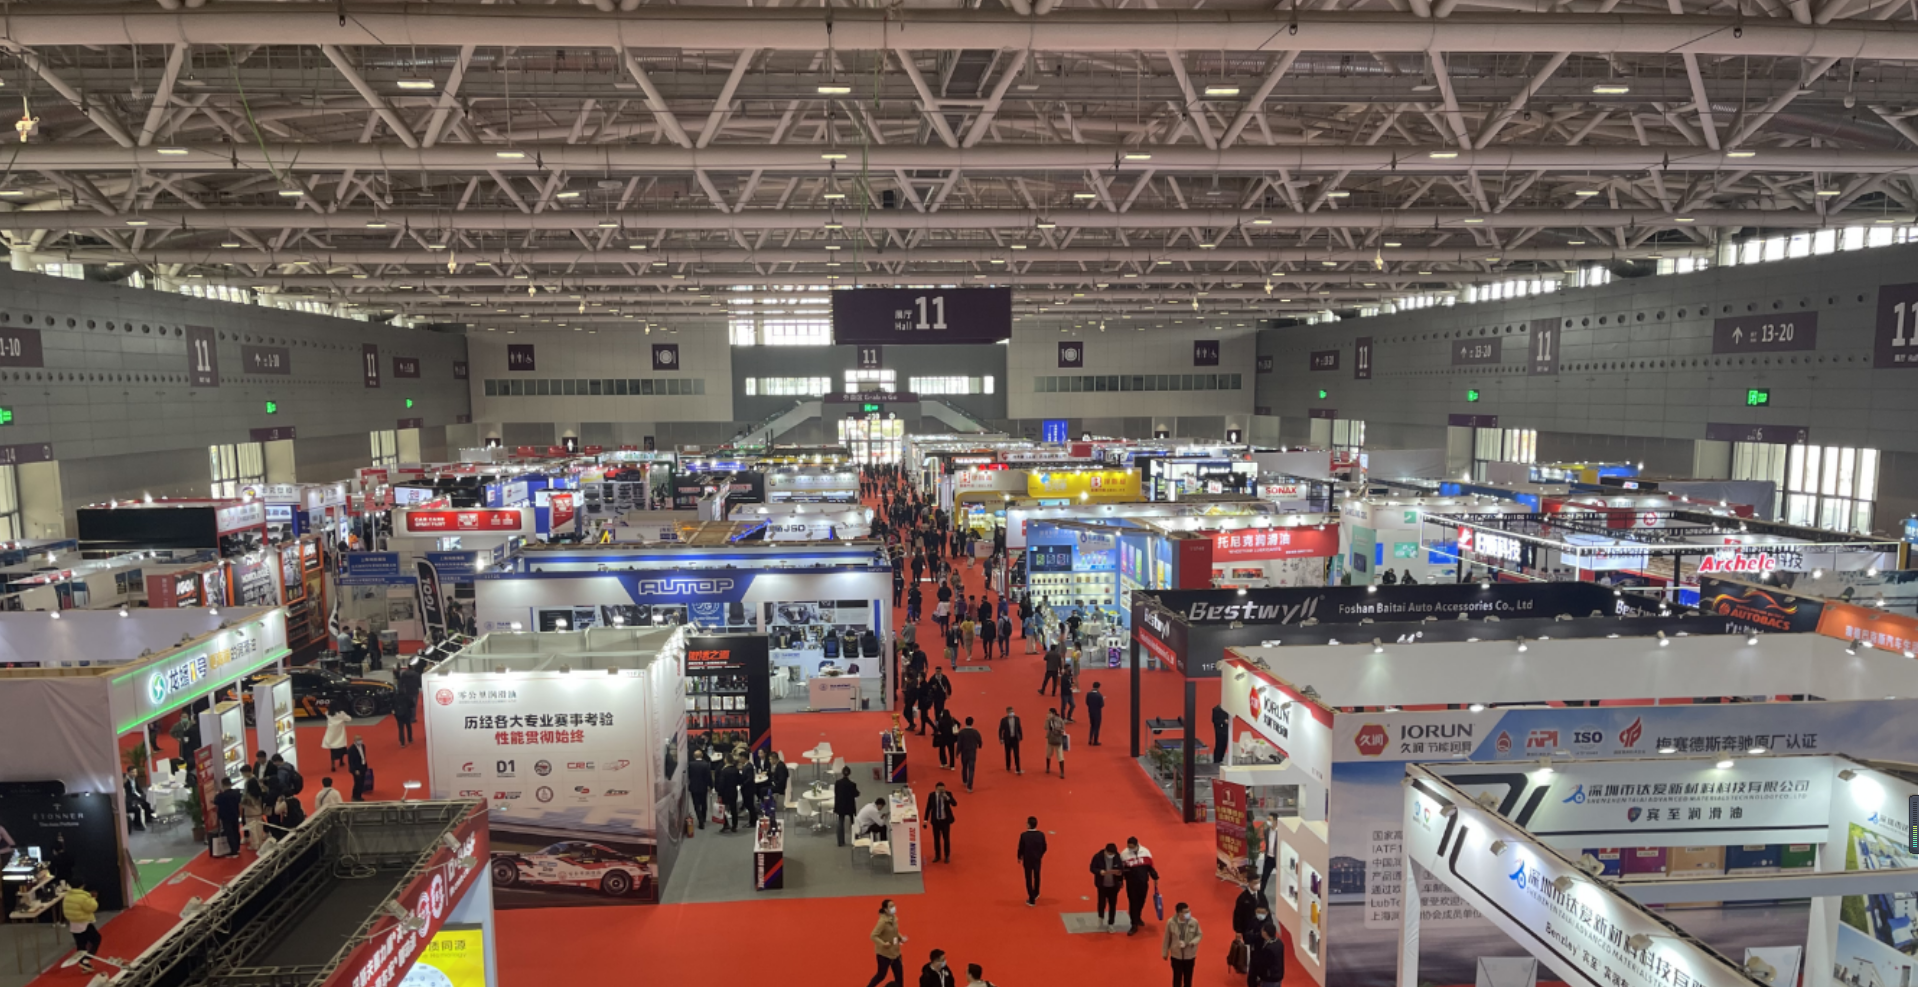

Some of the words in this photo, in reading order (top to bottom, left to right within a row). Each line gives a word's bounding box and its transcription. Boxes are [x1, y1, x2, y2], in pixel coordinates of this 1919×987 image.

[915, 296, 948, 330] 11
[895, 322, 912, 330] Hall
[1761, 323, 1794, 342] 13-20
[1475, 345, 1491, 358] 13-20
[1537, 331, 1551, 361] 11
[195, 339, 211, 371] 11
[863, 349, 877, 364] 11
[1359, 346, 1368, 369] 11
[366, 353, 376, 377] 11
[1756, 428, 1762, 441] 6
[1265, 486, 1297, 494] SONAX
[1217, 533, 1291, 549] 托尼克润滑油
[1698, 553, 1776, 572] Archele
[638, 578, 734, 595] AUTOP
[1339, 603, 1375, 614] Foshan
[1377, 602, 1406, 613] Baitai
[1408, 602, 1433, 612] Auto
[1435, 600, 1493, 611] Accessories
[1517, 599, 1533, 610] Ltd
[1730, 608, 1791, 630] AUTOBACS
[1264, 695, 1290, 725] JORUN
[464, 712, 614, 730] 历经各大专业赛事考验
[495, 730, 585, 745] 性能贯彻始终
[1359, 733, 1384, 747] 久润
[1401, 723, 1473, 740] JORUN
[1526, 730, 1559, 747] API
[1574, 731, 1603, 744] ISO
[1656, 733, 1818, 752] 梅赛德斯奔驰原厂认证
[496, 760, 515, 773] D1
[1646, 806, 1743, 821] 宾至润滑油
